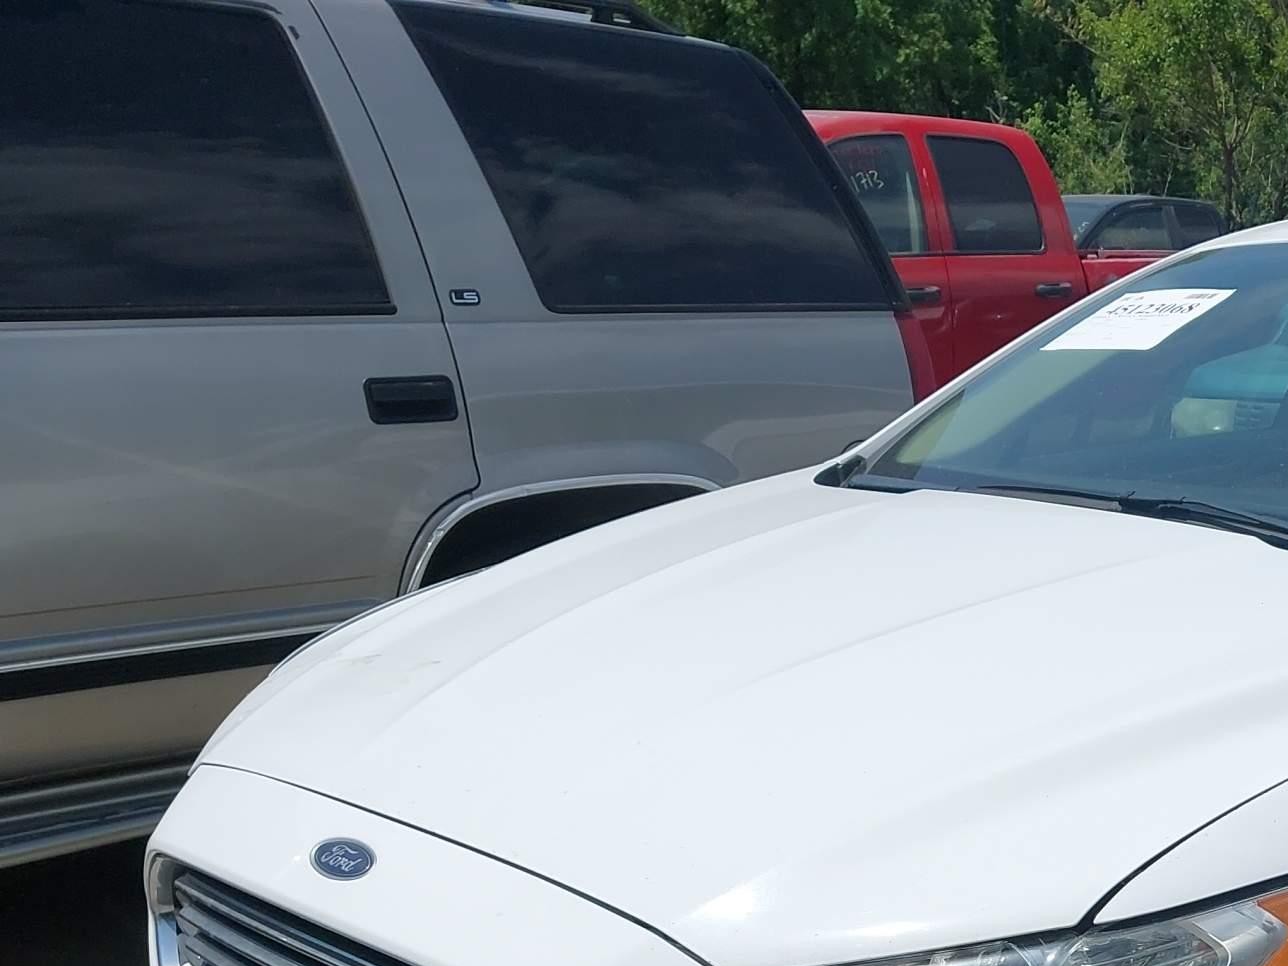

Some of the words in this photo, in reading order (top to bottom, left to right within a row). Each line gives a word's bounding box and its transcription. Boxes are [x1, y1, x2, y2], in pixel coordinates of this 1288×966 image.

[450, 291, 479, 304] LS
[1106, 302, 1200, 315] 45123068
[320, 844, 363, 872] Ford
